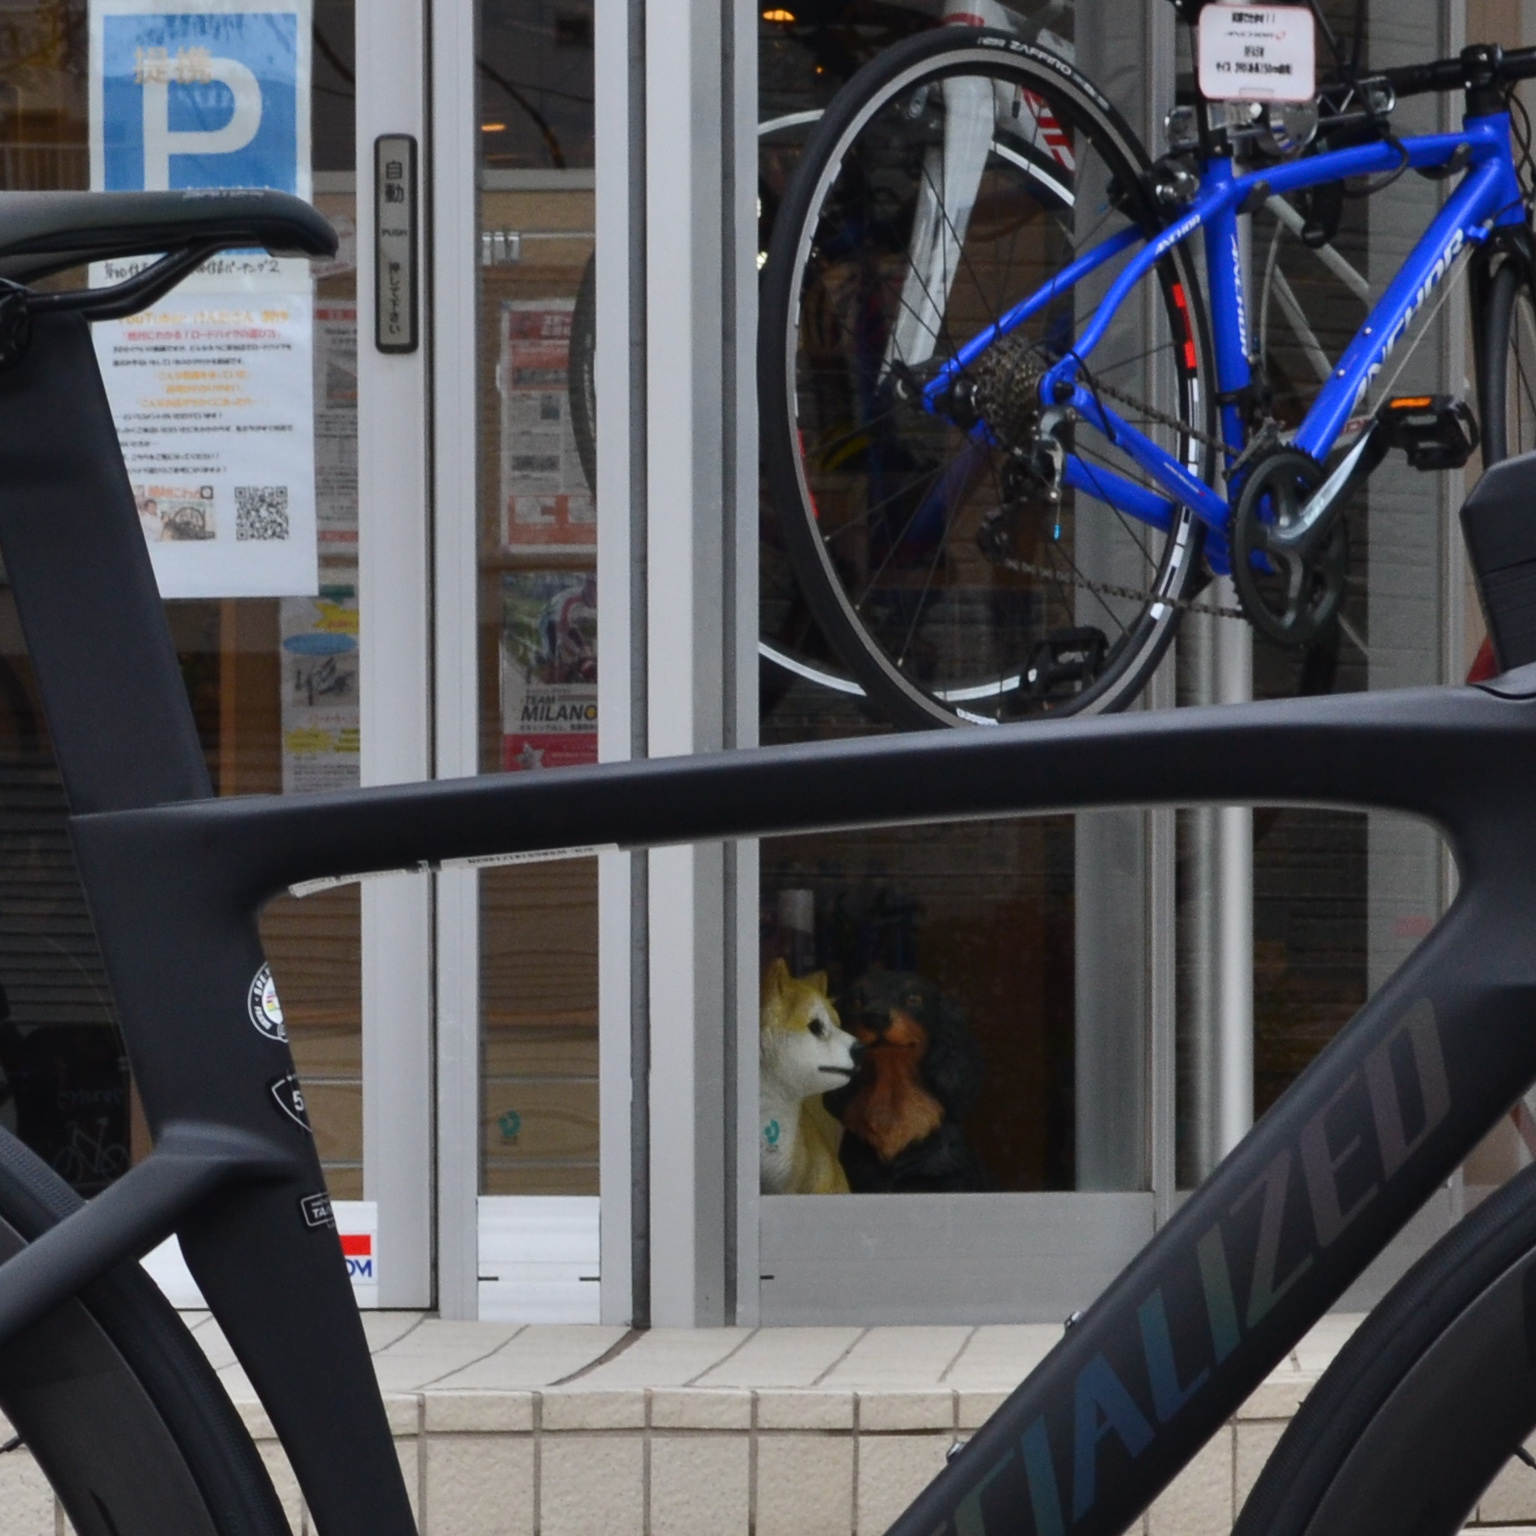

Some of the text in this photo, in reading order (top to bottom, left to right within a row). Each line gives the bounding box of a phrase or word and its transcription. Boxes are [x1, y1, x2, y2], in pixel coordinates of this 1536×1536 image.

[1010, 40, 1073, 76] ZAFFIRO
[143, 58, 263, 192] P
[385, 160, 404, 203] 自動
[520, 703, 598, 722] MILANO
